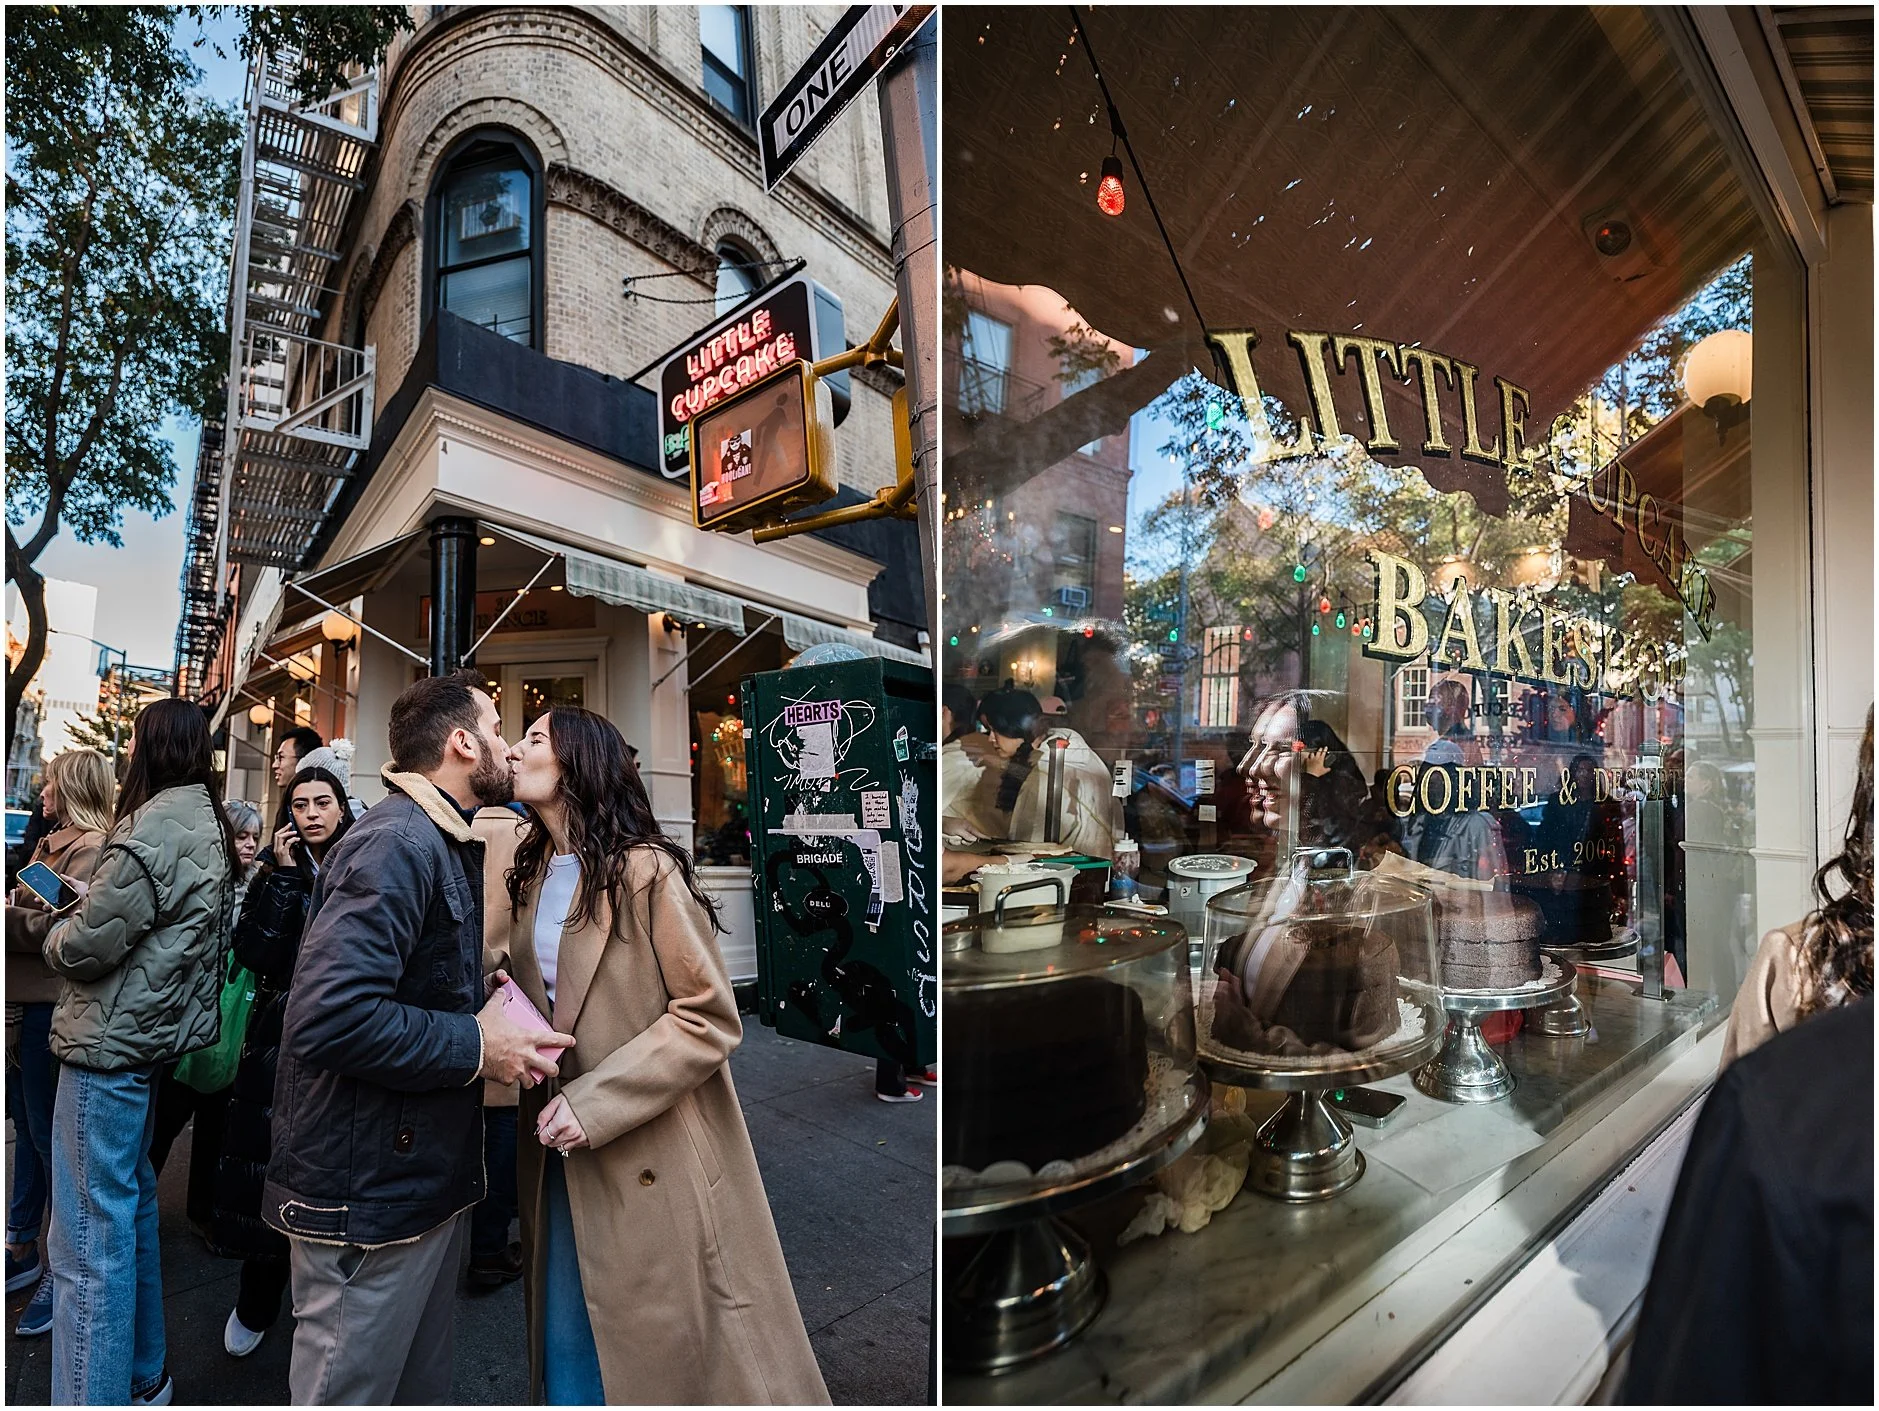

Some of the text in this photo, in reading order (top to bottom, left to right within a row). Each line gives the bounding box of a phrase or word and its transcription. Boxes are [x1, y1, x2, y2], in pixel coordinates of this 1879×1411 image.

[786, 42, 852, 136] ONE
[670, 332, 796, 421] CUPCAKE
[686, 309, 772, 380] LITTLE
[1205, 327, 1535, 474] LITTLE
[1550, 413, 1717, 643] CUPCAKE
[1362, 548, 1687, 706] BAKESHOP
[787, 702, 840, 723] HEARTS
[1384, 764, 1683, 818] COFFEE & DESSERT
[796, 853, 843, 864] BRIGADE
[1523, 848, 1566, 876] Est.
